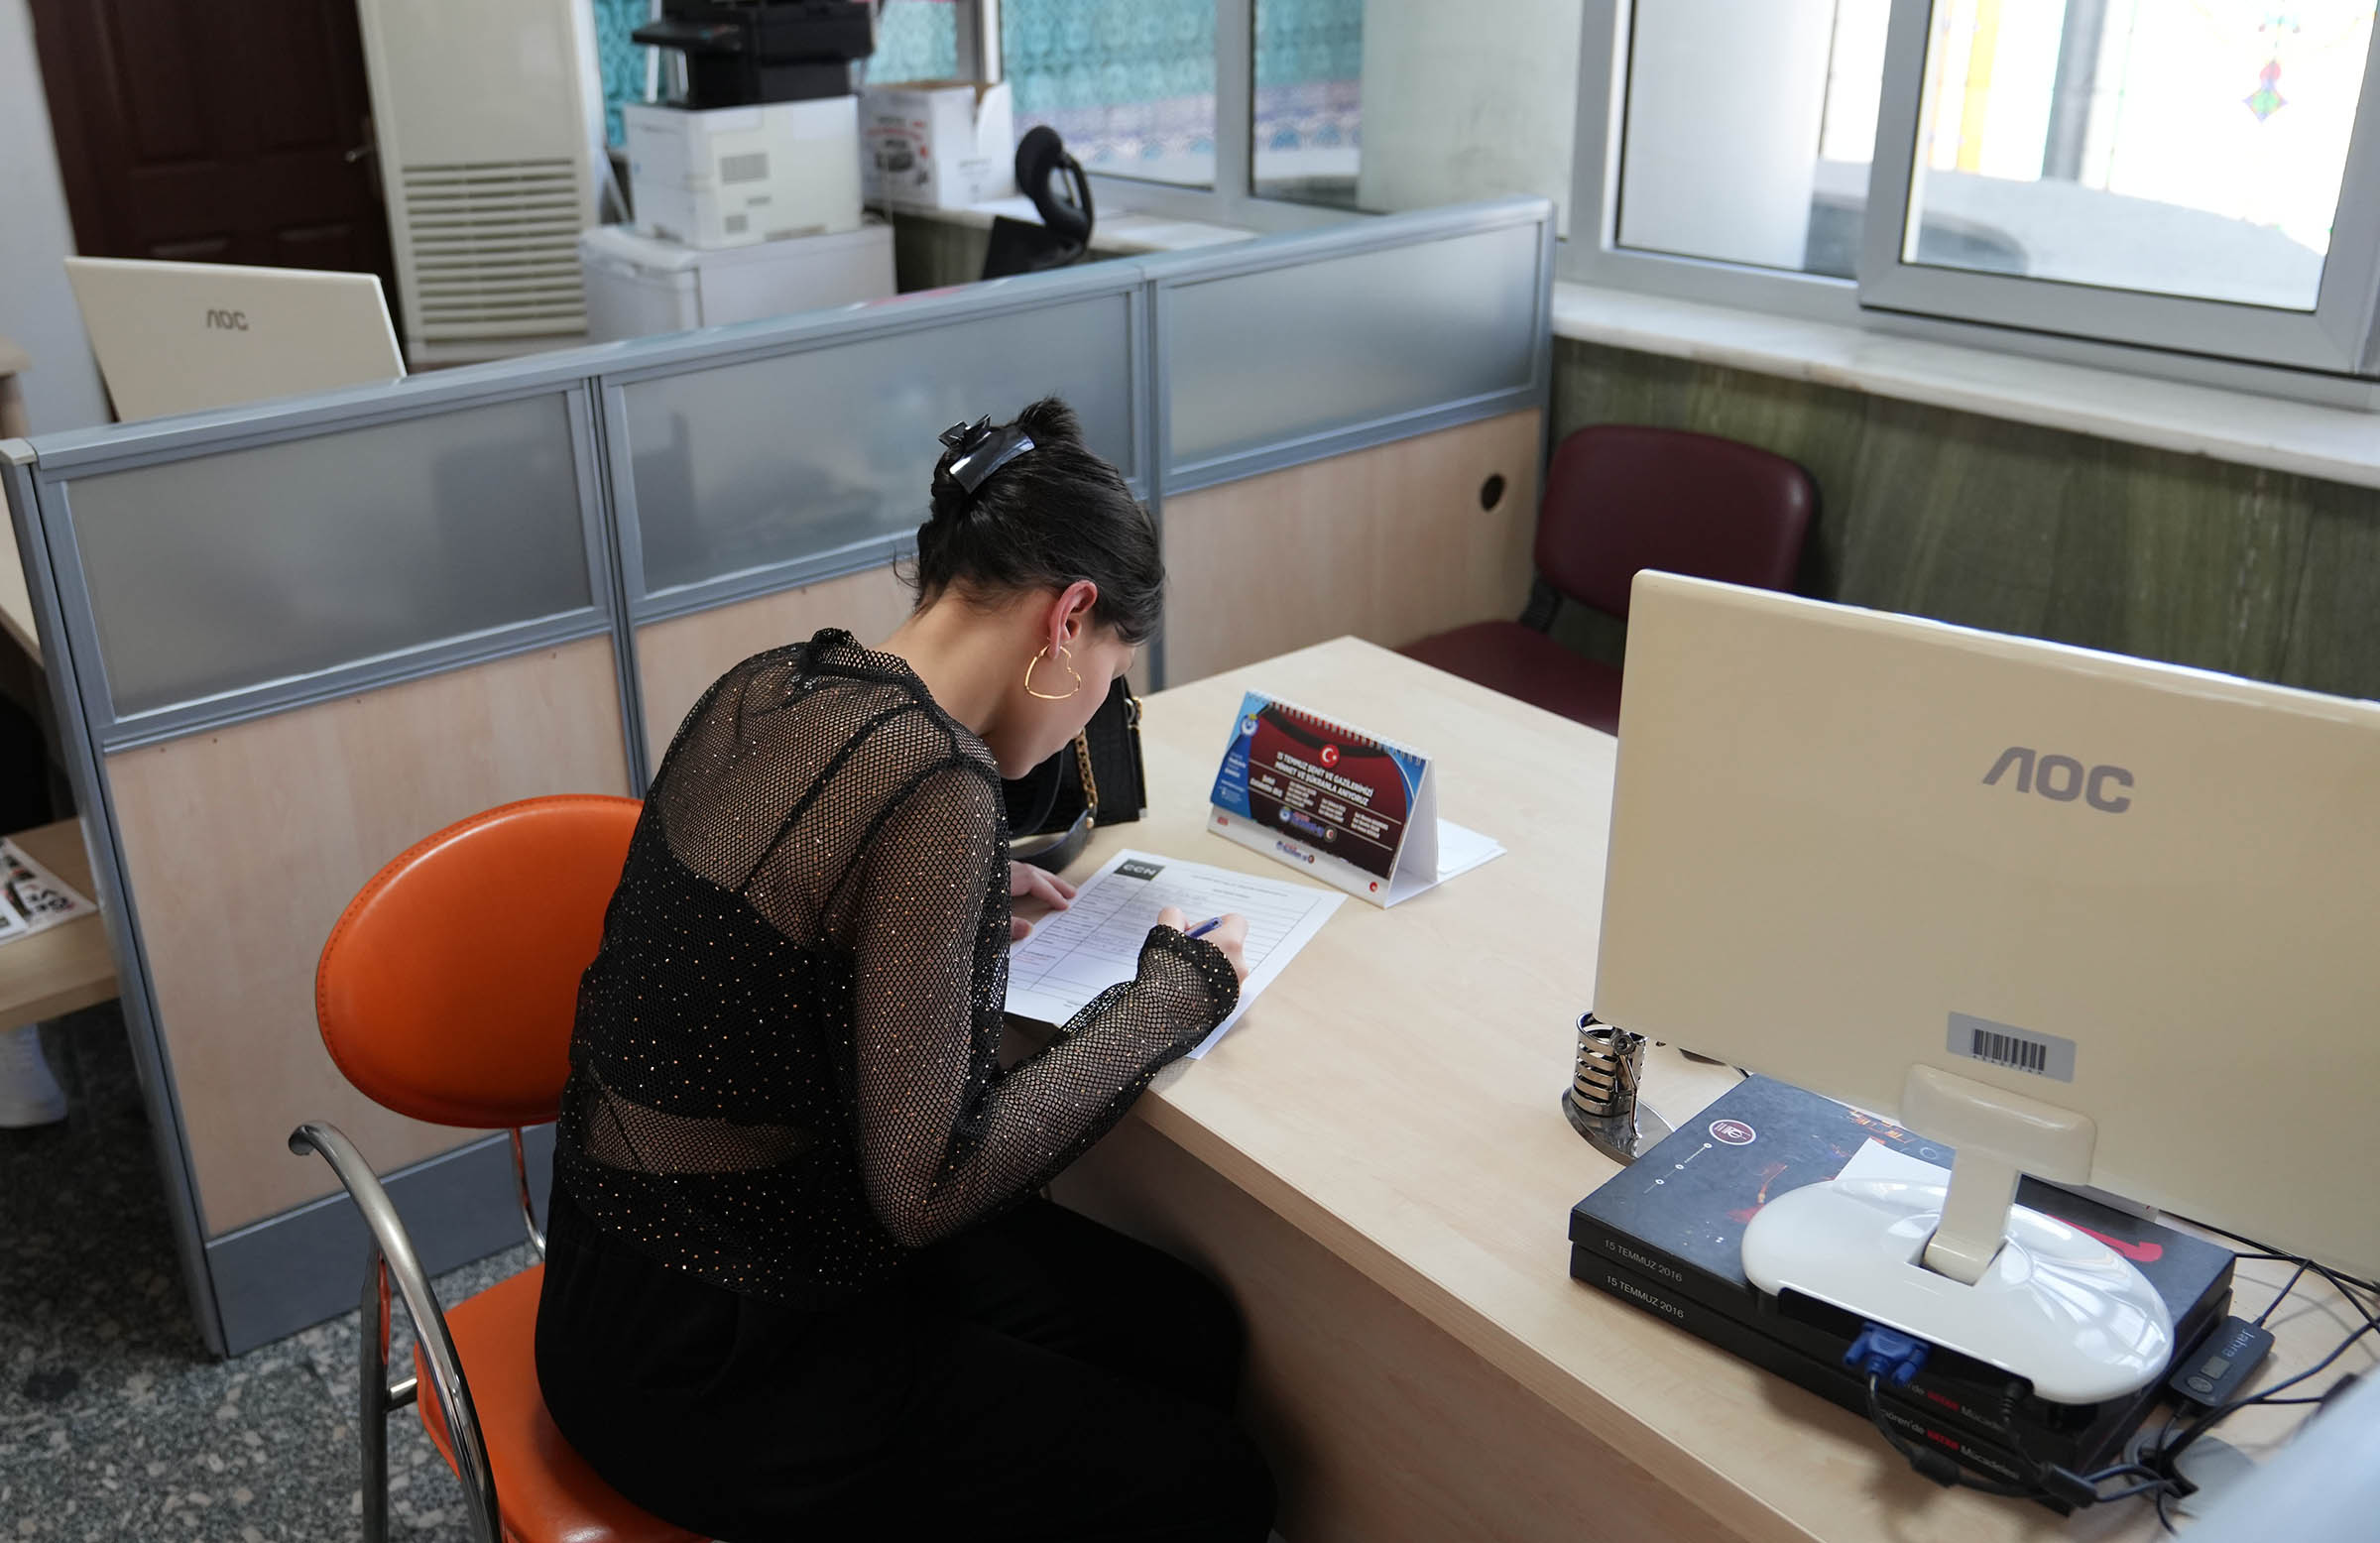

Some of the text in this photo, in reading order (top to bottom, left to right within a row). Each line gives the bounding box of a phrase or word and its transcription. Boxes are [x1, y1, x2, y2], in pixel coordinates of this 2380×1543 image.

[206, 308, 249, 331] AOC
[1981, 746, 2135, 814] AOC
[1605, 1240, 1683, 1282] 15 TEMMUZ 2016
[1606, 1275, 1685, 1319] 15 TEMMUZ 2016
[2220, 1329, 2256, 1358] Jabra
